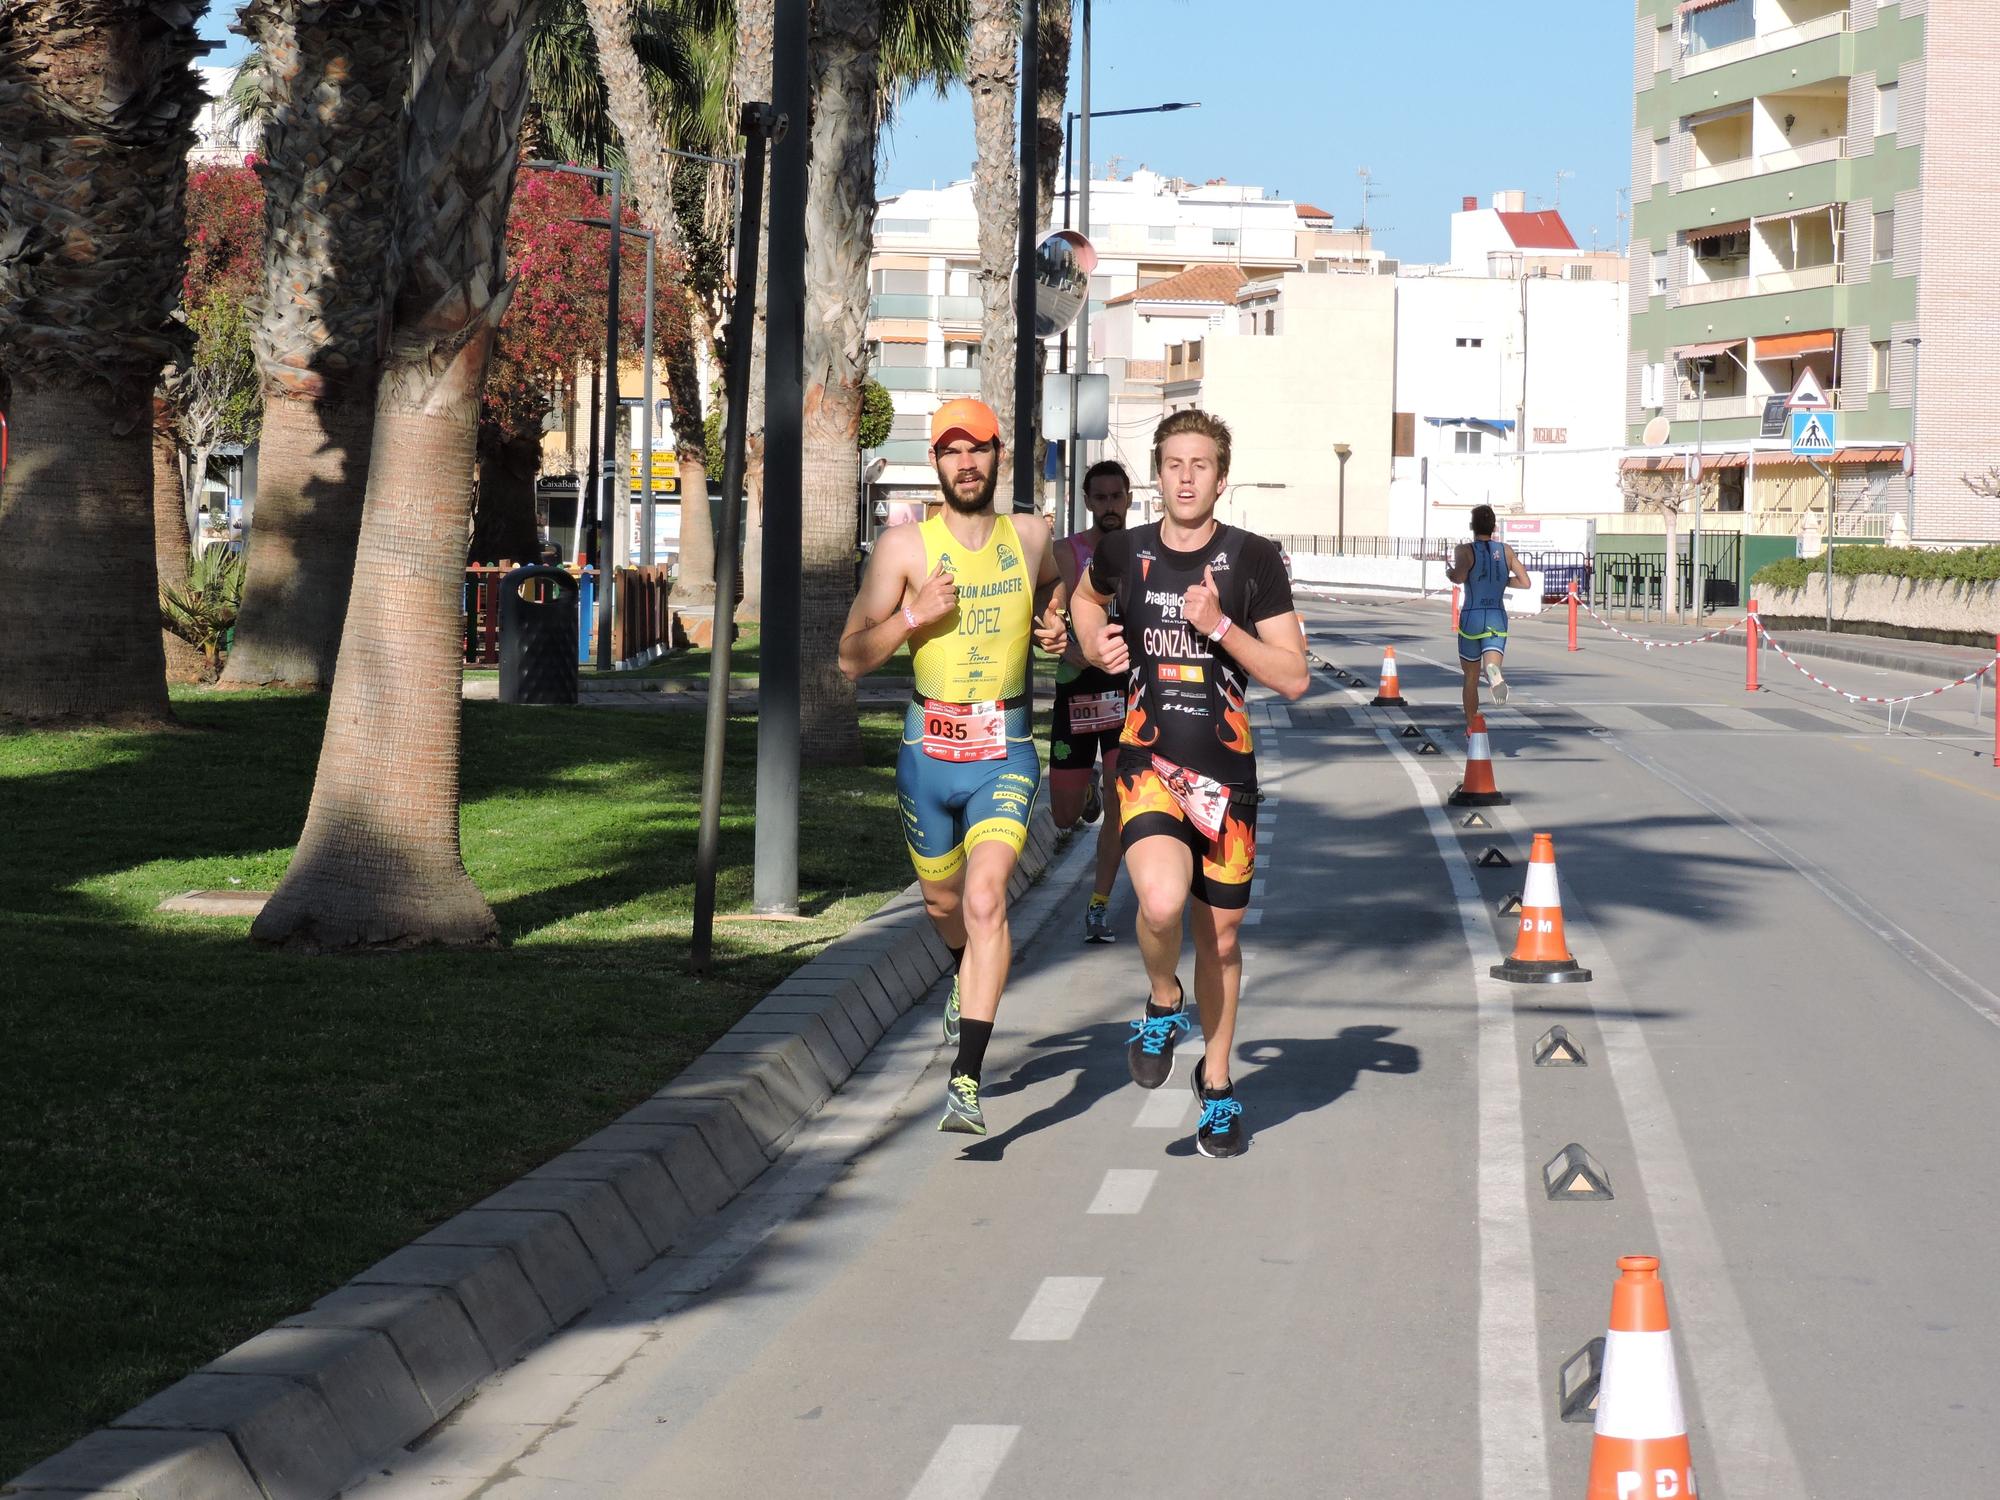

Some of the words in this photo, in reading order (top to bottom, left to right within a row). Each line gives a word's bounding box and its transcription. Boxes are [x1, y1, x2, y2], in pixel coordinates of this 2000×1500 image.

[540, 479, 581, 488] CaixaBank
[980, 577, 1022, 598] ALBACETE
[959, 603, 1001, 636] LÓPEZ
[1144, 625, 1214, 659] GONZÁLEZ
[1161, 668, 1177, 677] TM
[1073, 706, 1099, 719] 001
[929, 718, 968, 741] 035
